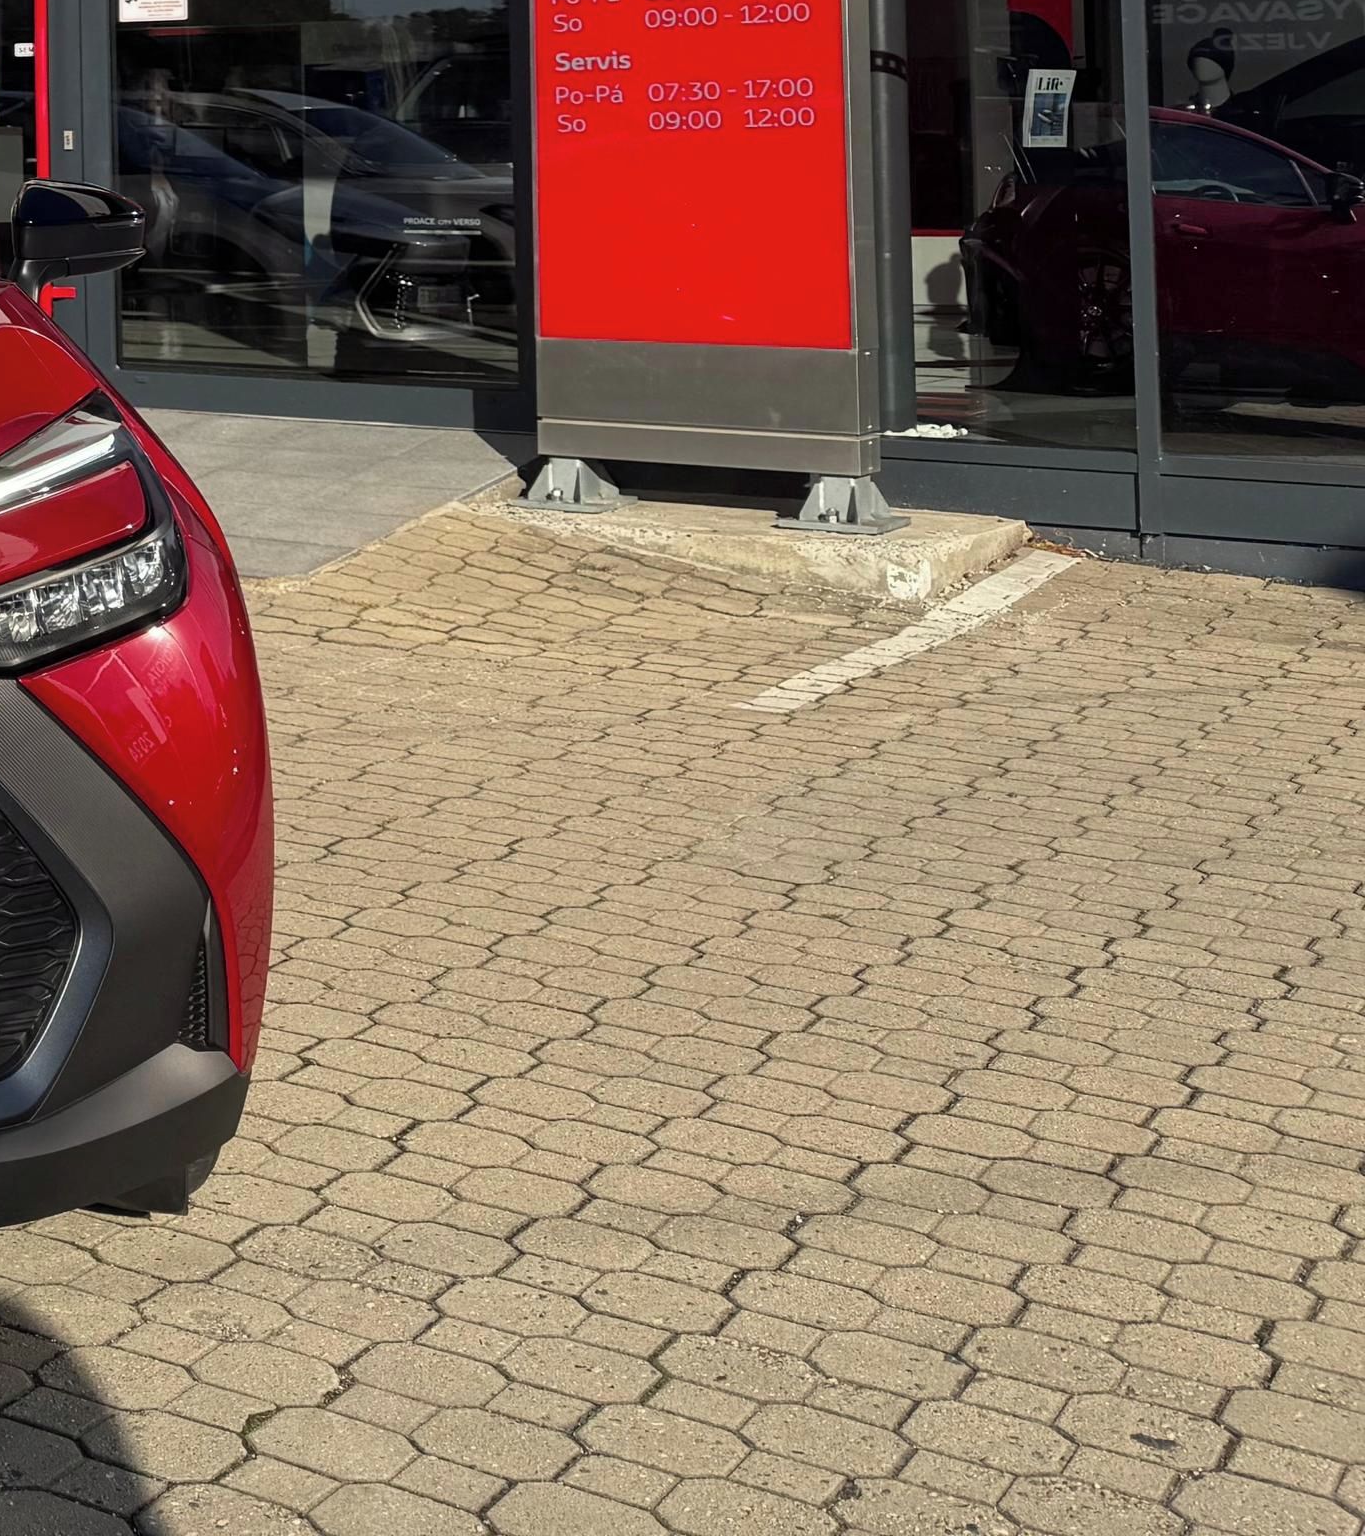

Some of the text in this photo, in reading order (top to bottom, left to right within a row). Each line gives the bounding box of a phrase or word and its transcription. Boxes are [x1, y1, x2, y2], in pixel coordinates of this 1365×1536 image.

[553, 14, 583, 33] So
[644, 7, 717, 28] 09:00
[740, 2, 811, 24] 12:00
[555, 51, 631, 72] Servis
[555, 84, 624, 105] Po-Pá
[648, 81, 721, 102] 07:30
[743, 78, 814, 99] 17:00
[557, 107, 815, 133] So 09:00 12:00
